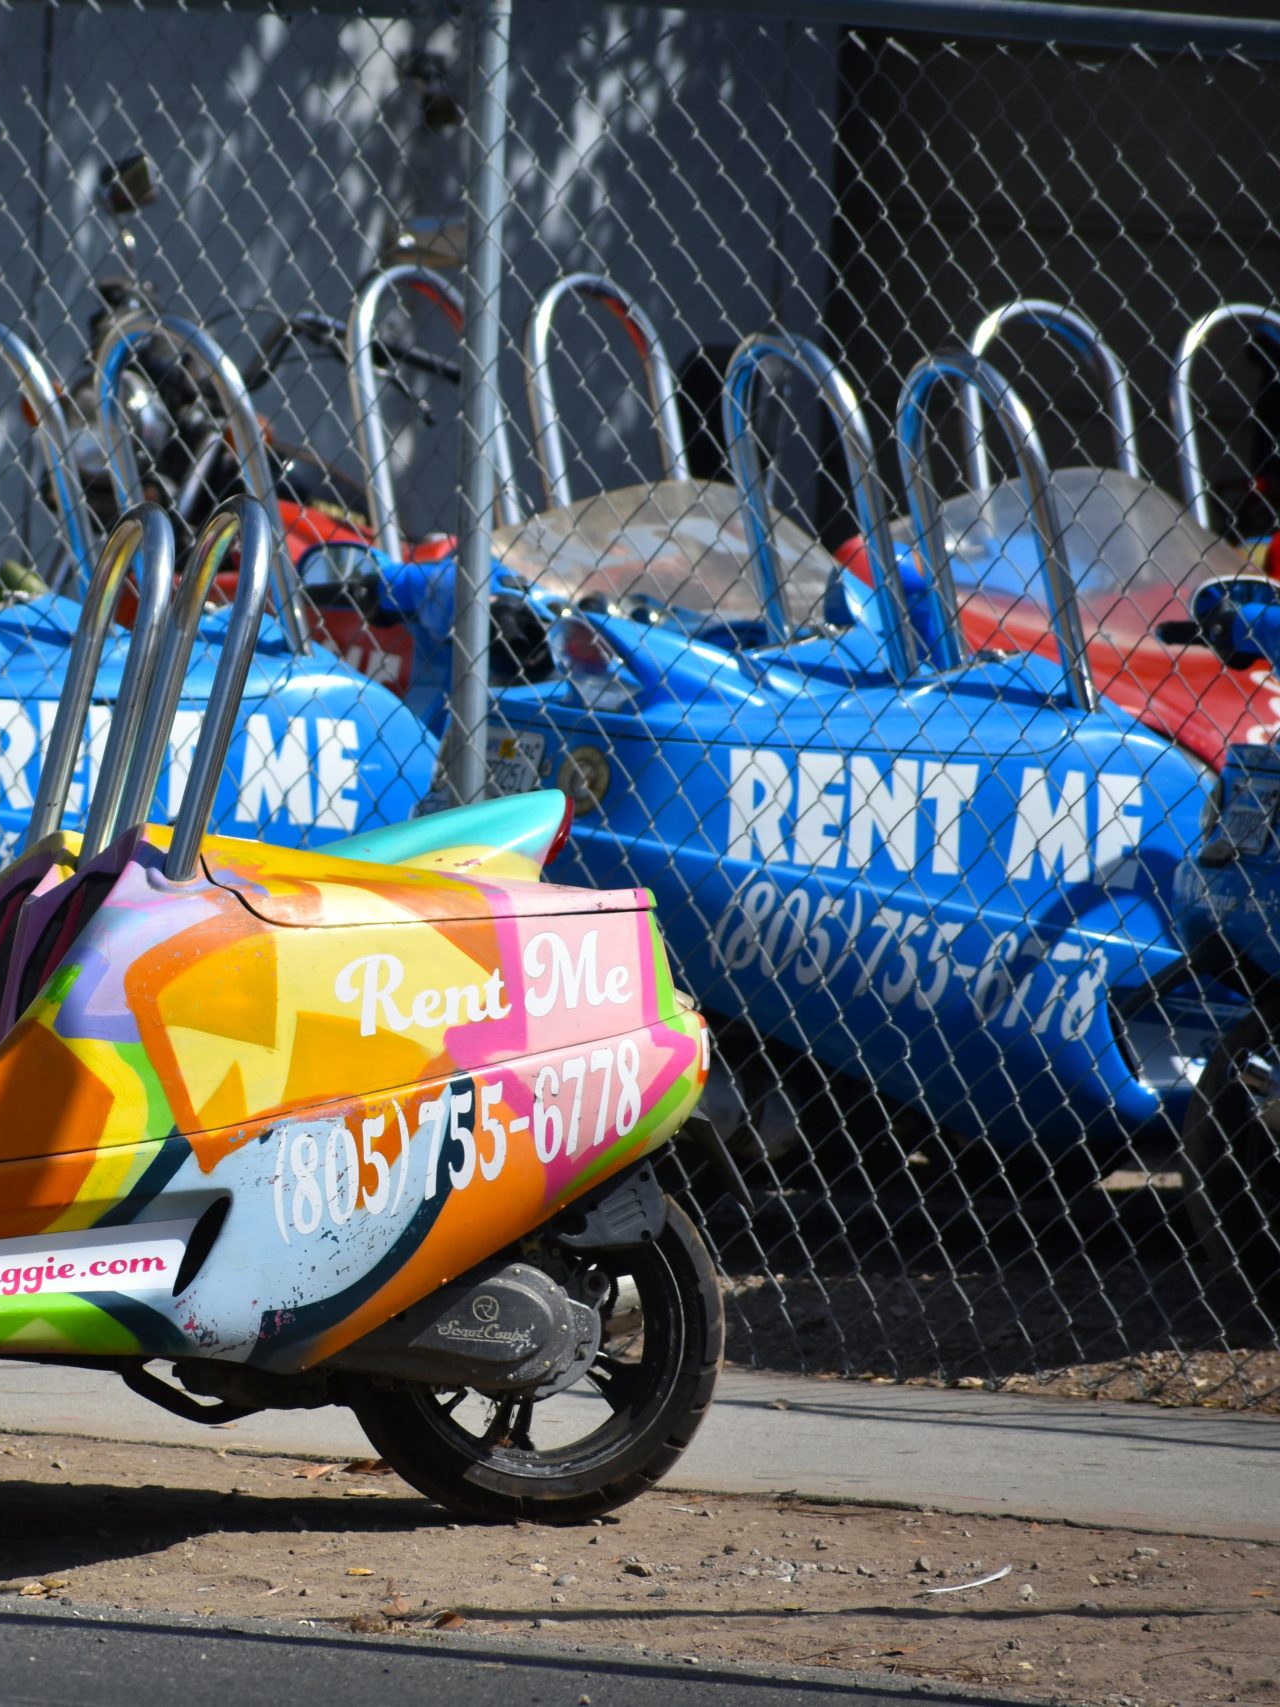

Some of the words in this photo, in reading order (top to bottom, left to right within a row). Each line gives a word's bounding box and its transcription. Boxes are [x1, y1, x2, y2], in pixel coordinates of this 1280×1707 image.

[235, 713, 361, 831] ME
[727, 748, 979, 875] RENT
[1006, 766, 1144, 890] ME
[334, 953, 512, 1037] Rent
[522, 929, 633, 1018] Me
[709, 868, 1108, 1042] (805)755-6778
[273, 1038, 643, 1246] (805)755-6778
